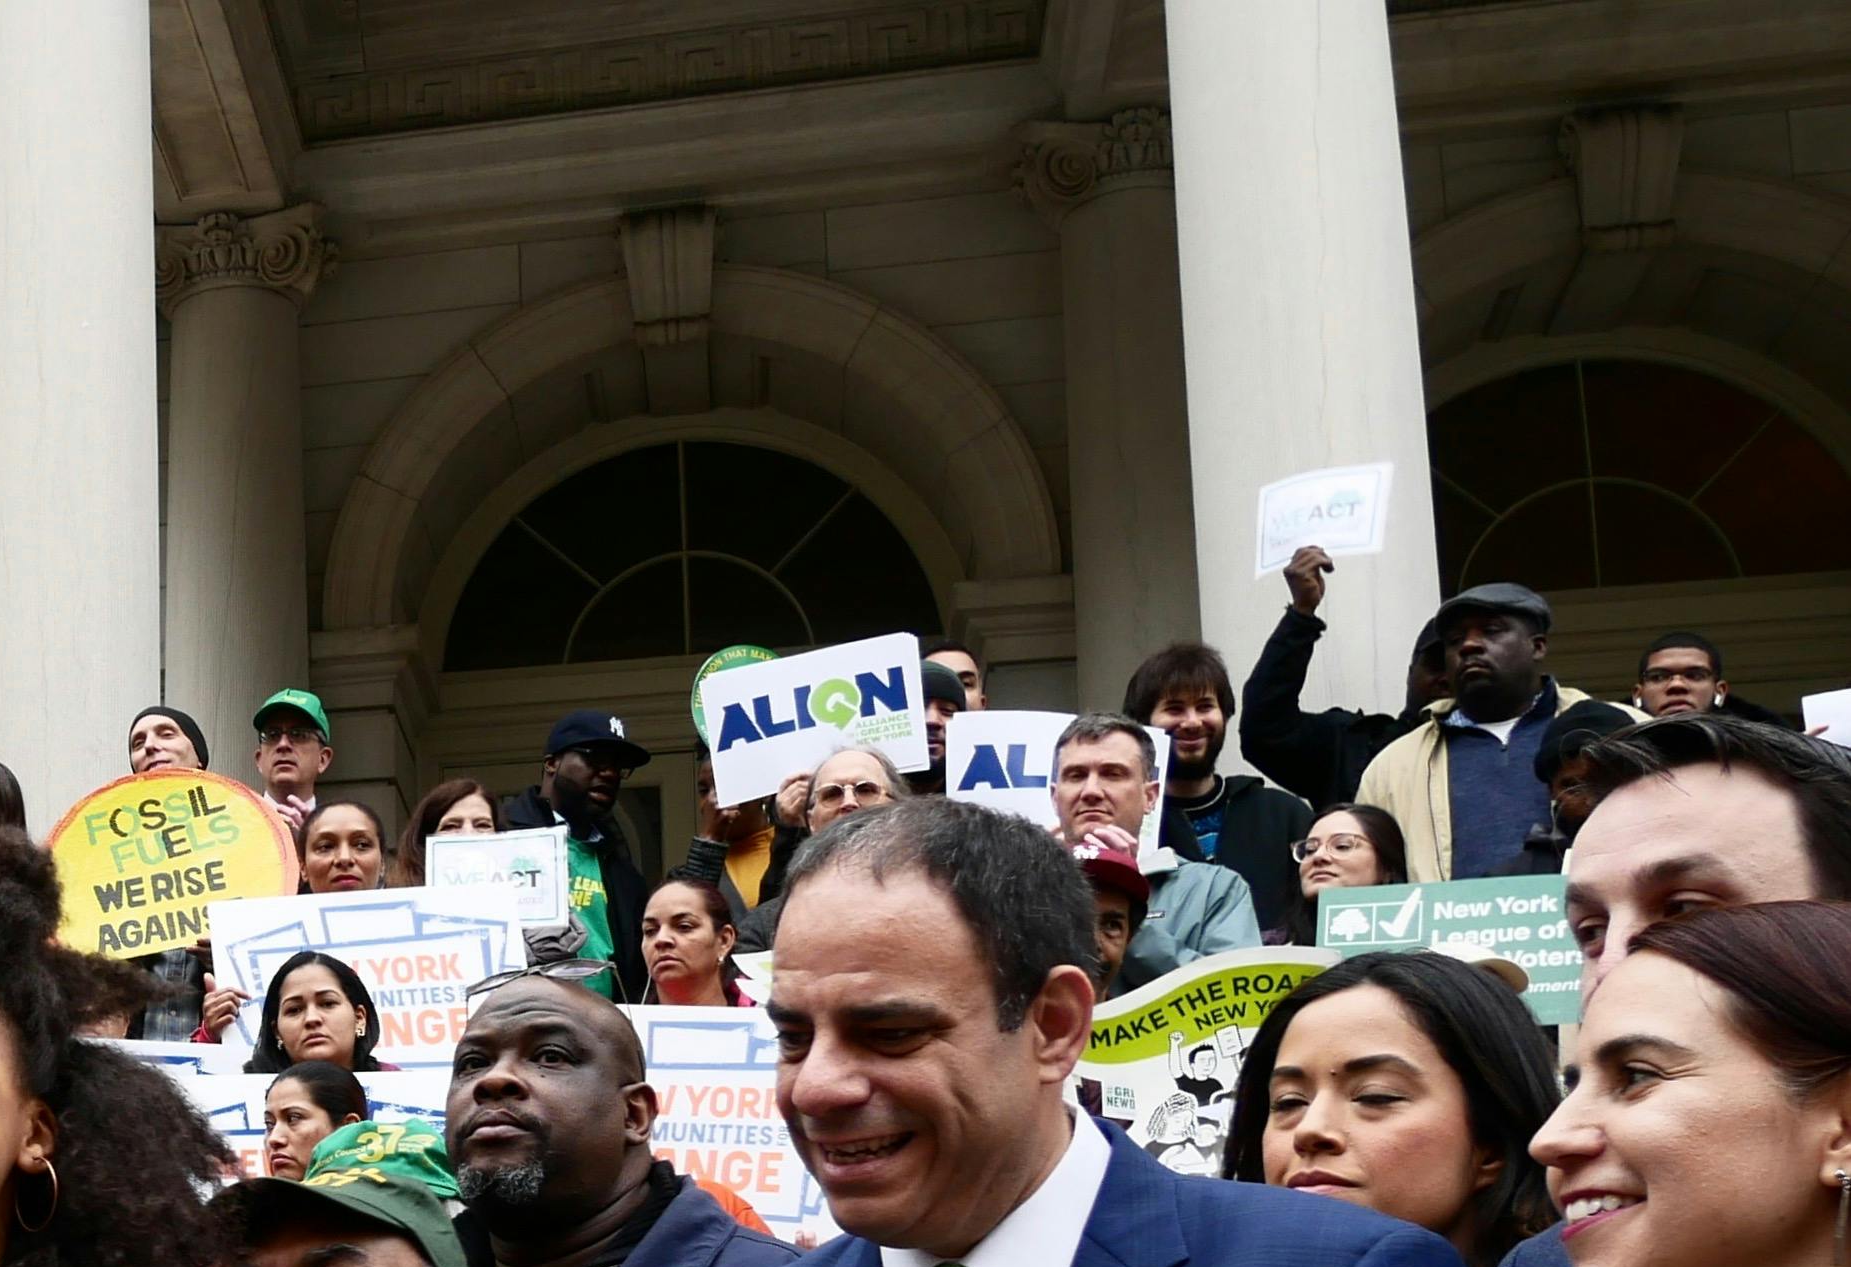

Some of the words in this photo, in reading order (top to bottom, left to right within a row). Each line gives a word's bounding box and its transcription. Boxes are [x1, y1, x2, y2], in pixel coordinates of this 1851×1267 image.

[1308, 502, 1358, 521] ACT
[717, 666, 909, 753] ALIGN
[957, 744, 1050, 791] AL
[84, 786, 226, 846] FOSSIL
[110, 814, 241, 874] FUELS
[93, 877, 147, 913] WE
[151, 860, 227, 903] RISE
[1434, 901, 1494, 920] New
[1496, 894, 1558, 915] York
[1432, 925, 1537, 948] League
[1538, 919, 1569, 939] of
[367, 952, 464, 985] YORK
[1505, 949, 1584, 969] Voters
[1090, 1008, 1169, 1050] MAKE
[1168, 980, 1226, 1018] THE
[1194, 1002, 1247, 1031] NEW
[357, 1124, 406, 1164] 37
